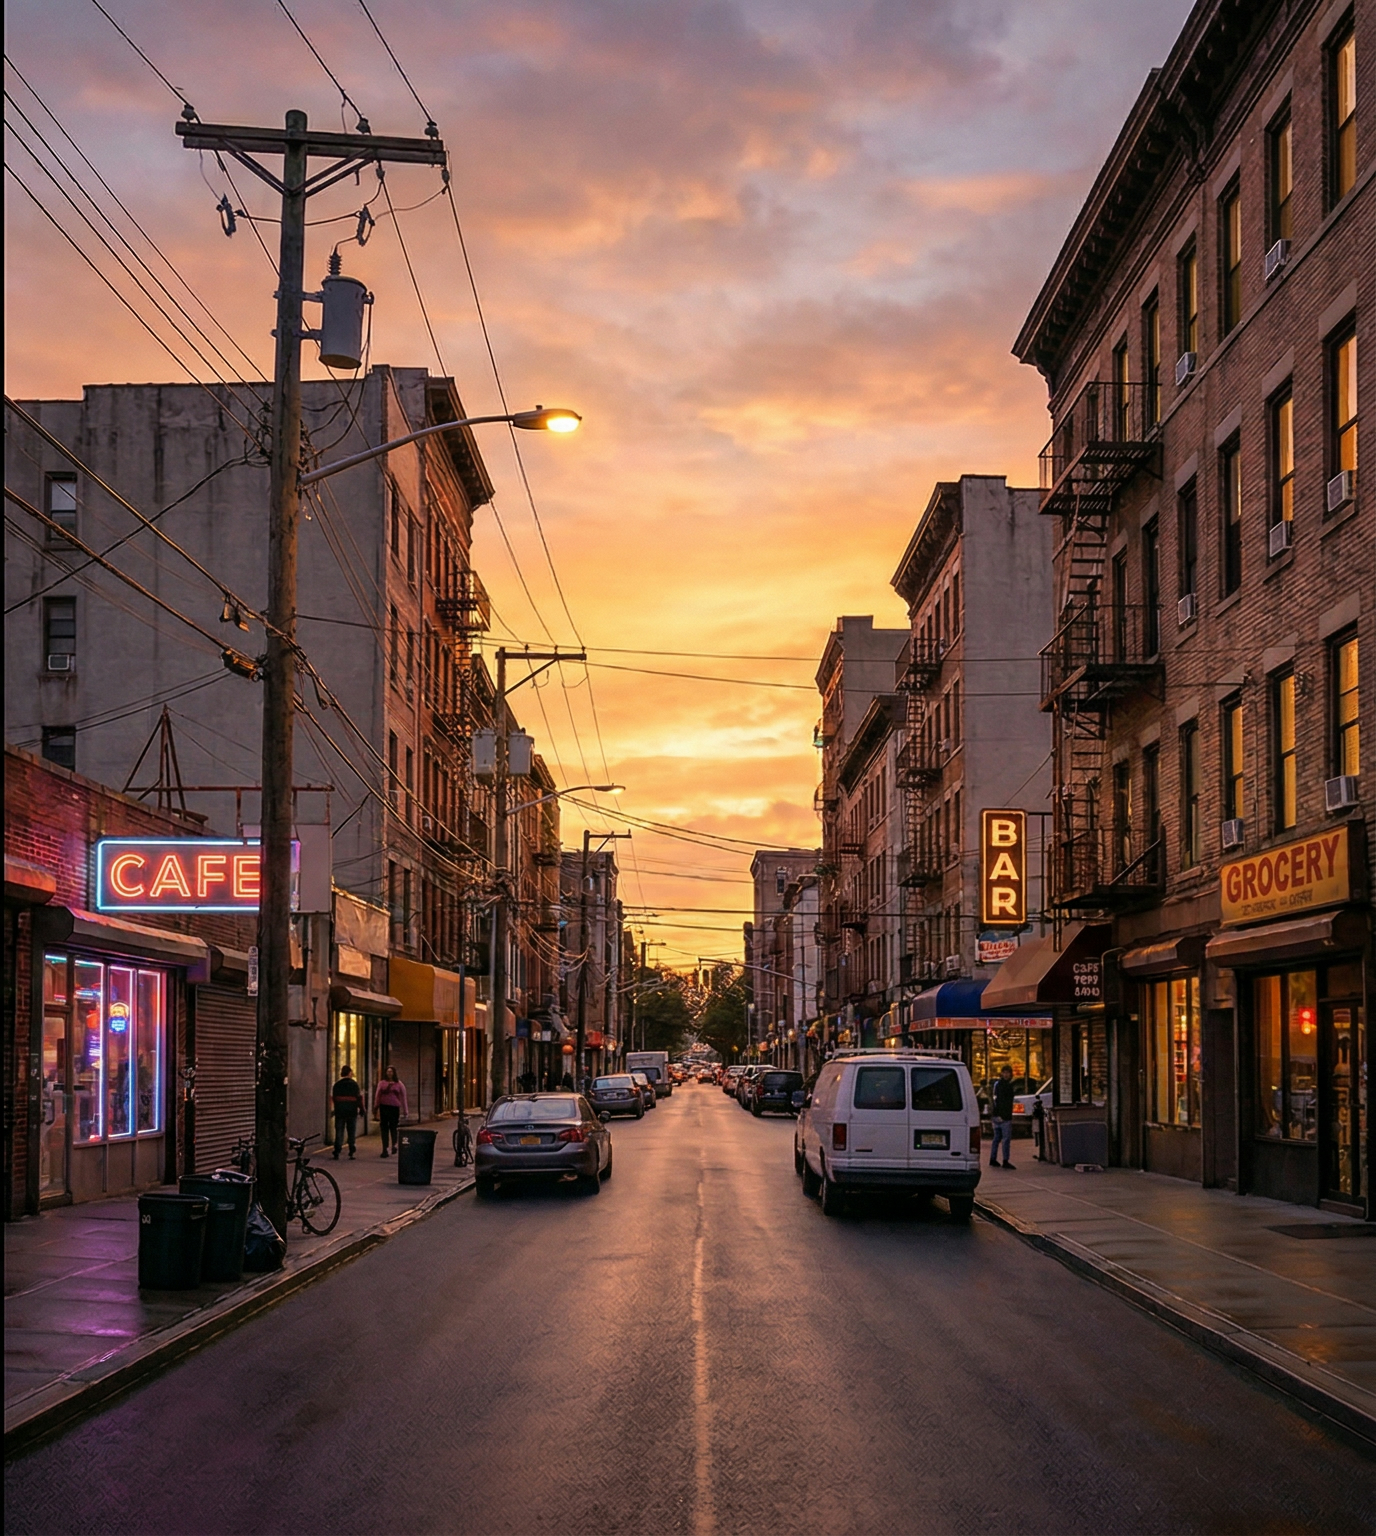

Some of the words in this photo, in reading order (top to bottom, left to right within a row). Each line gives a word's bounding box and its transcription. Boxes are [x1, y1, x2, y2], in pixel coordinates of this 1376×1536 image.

[110, 854, 261, 898] CAFE
[989, 819, 1019, 916] BAR
[1226, 834, 1340, 903] GROCERY
